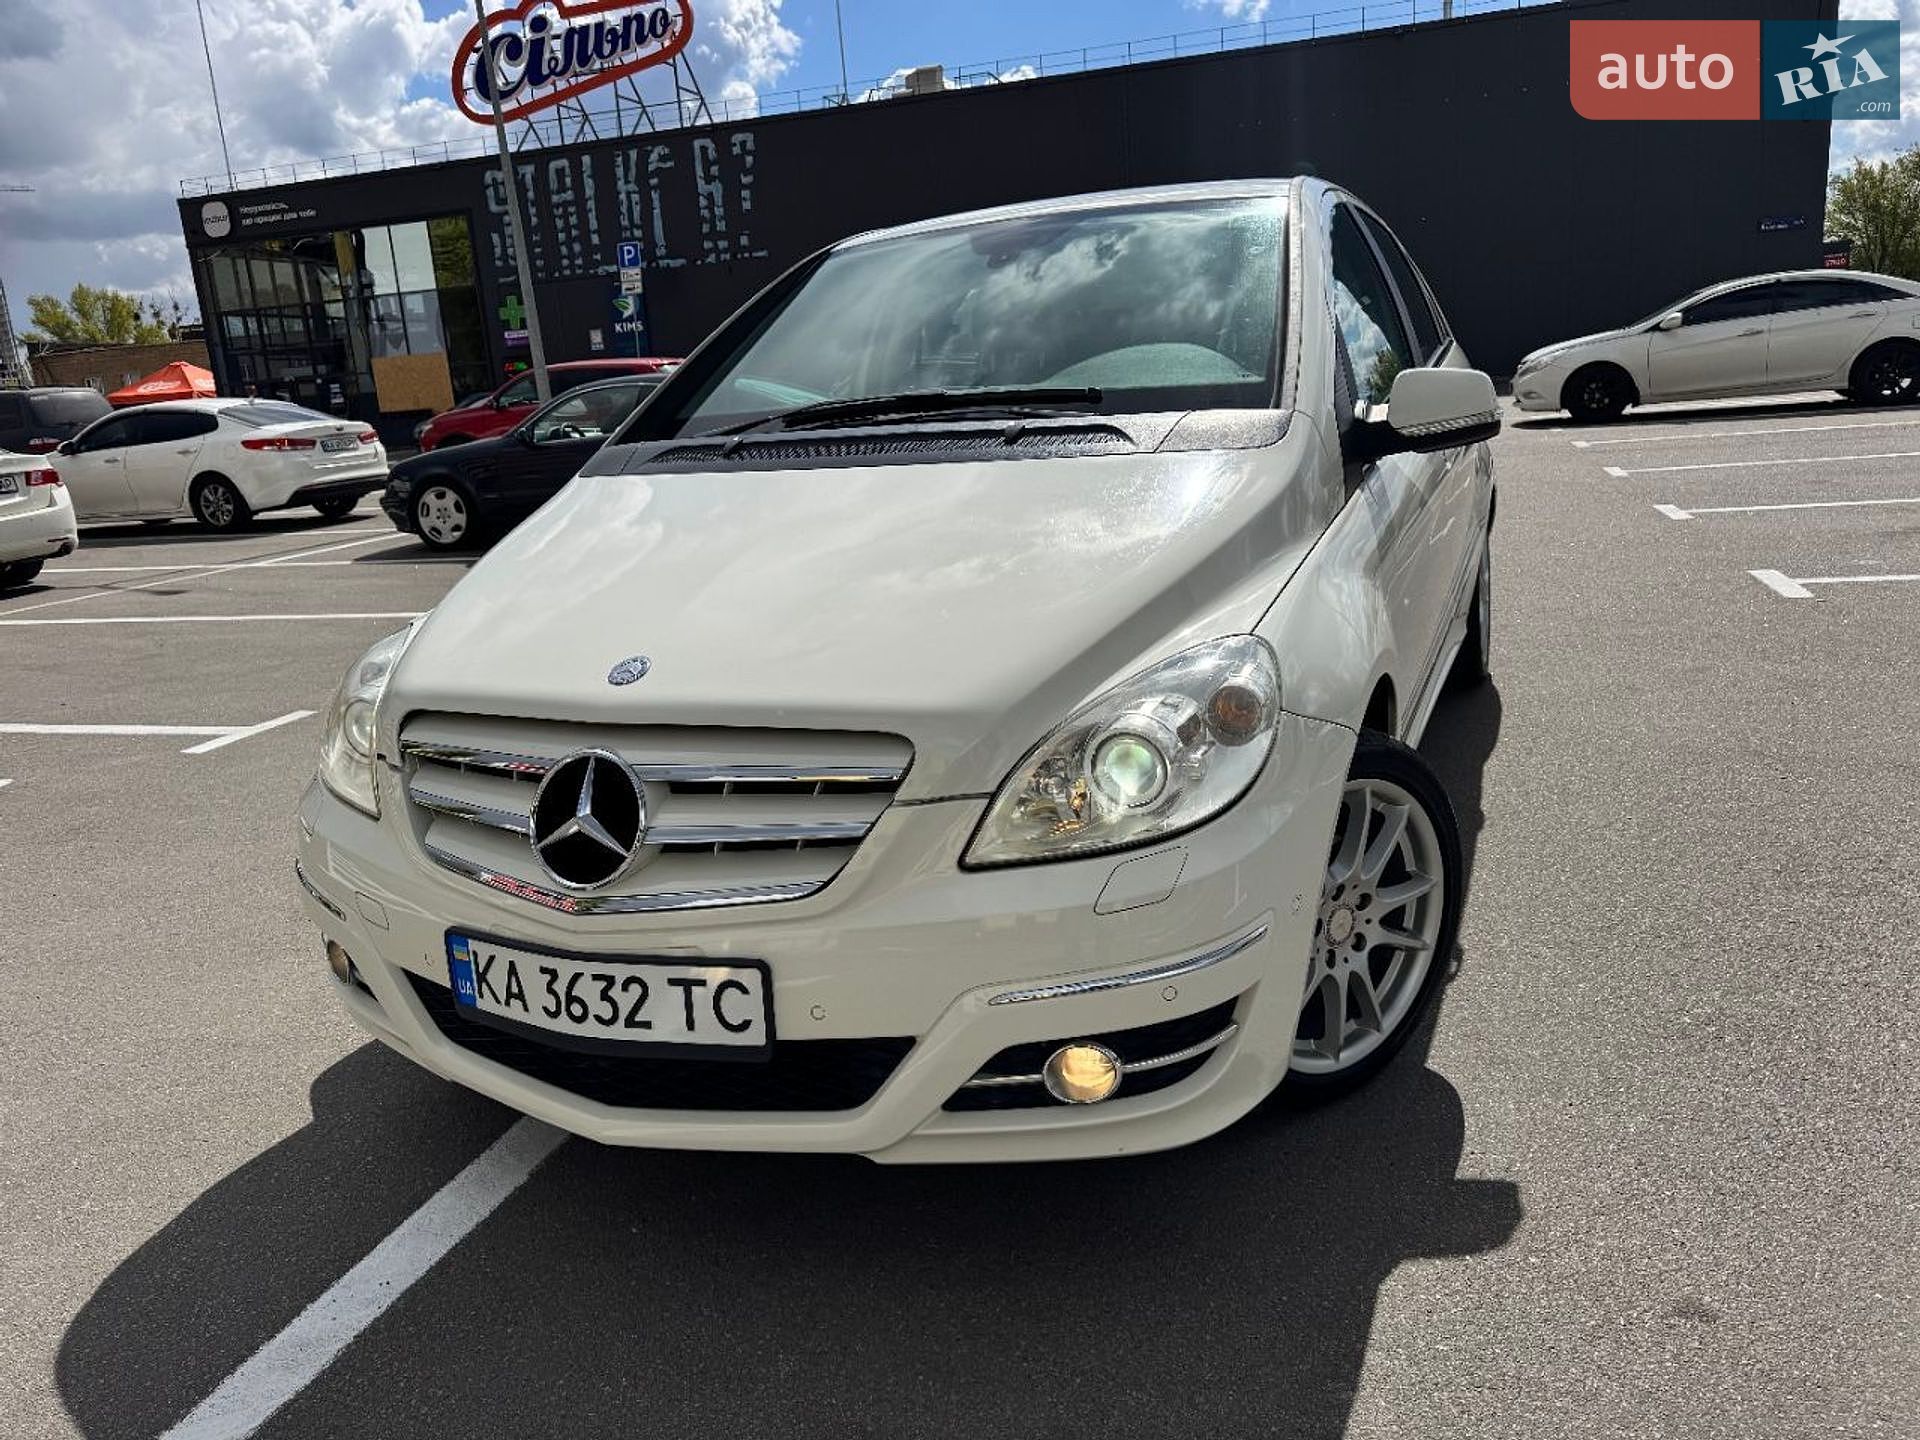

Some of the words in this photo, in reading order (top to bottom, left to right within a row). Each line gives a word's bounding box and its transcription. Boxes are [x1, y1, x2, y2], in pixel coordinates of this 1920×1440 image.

[474, 7, 672, 101] Сільпо
[623, 245, 635, 266] P
[614, 321, 645, 333] KIMS
[457, 977, 474, 995] UA
[473, 949, 529, 1013] KA
[539, 965, 652, 1030] 3632
[667, 977, 753, 1034] TC
